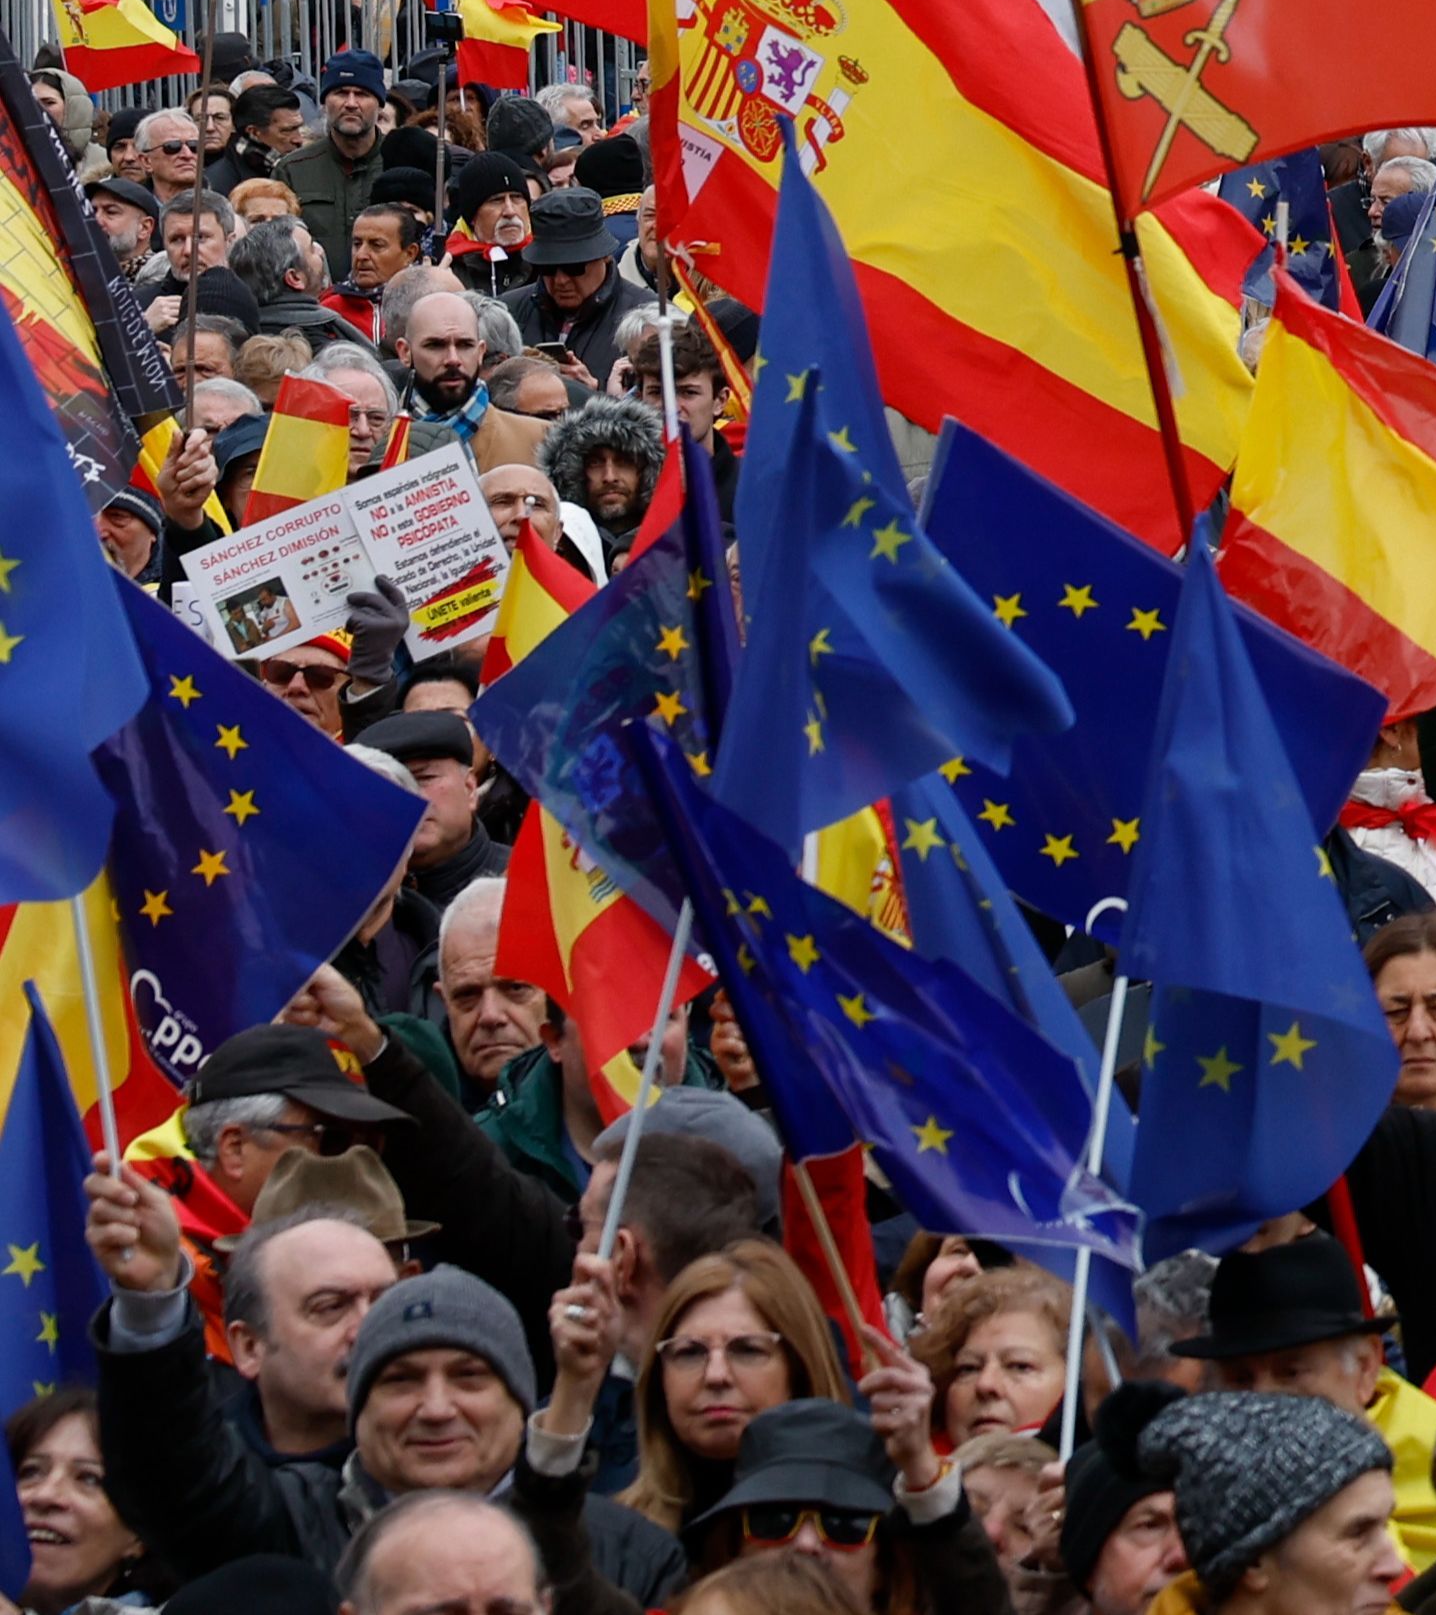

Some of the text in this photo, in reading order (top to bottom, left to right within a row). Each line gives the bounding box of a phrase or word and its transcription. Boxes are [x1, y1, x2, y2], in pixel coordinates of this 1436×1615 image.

[814, 98, 842, 136] VLTRA
[355, 495, 383, 511] Somos
[421, 462, 460, 485] indignados
[370, 505, 389, 522] NO
[370, 524, 389, 542] NO
[413, 489, 471, 523] GOBIERNO
[397, 514, 460, 549] PSICÓPATA
[199, 502, 342, 571] SÁNCHEZ CORRUPTO
[212, 551, 278, 586] SÁNCHEZ
[278, 524, 341, 559] DIMISIÓN
[394, 549, 429, 571] Estamos
[429, 533, 473, 557] defendiendo
[472, 536, 498, 554] Unidad
[426, 597, 459, 621] ÚNETE
[459, 587, 492, 608] valiente
